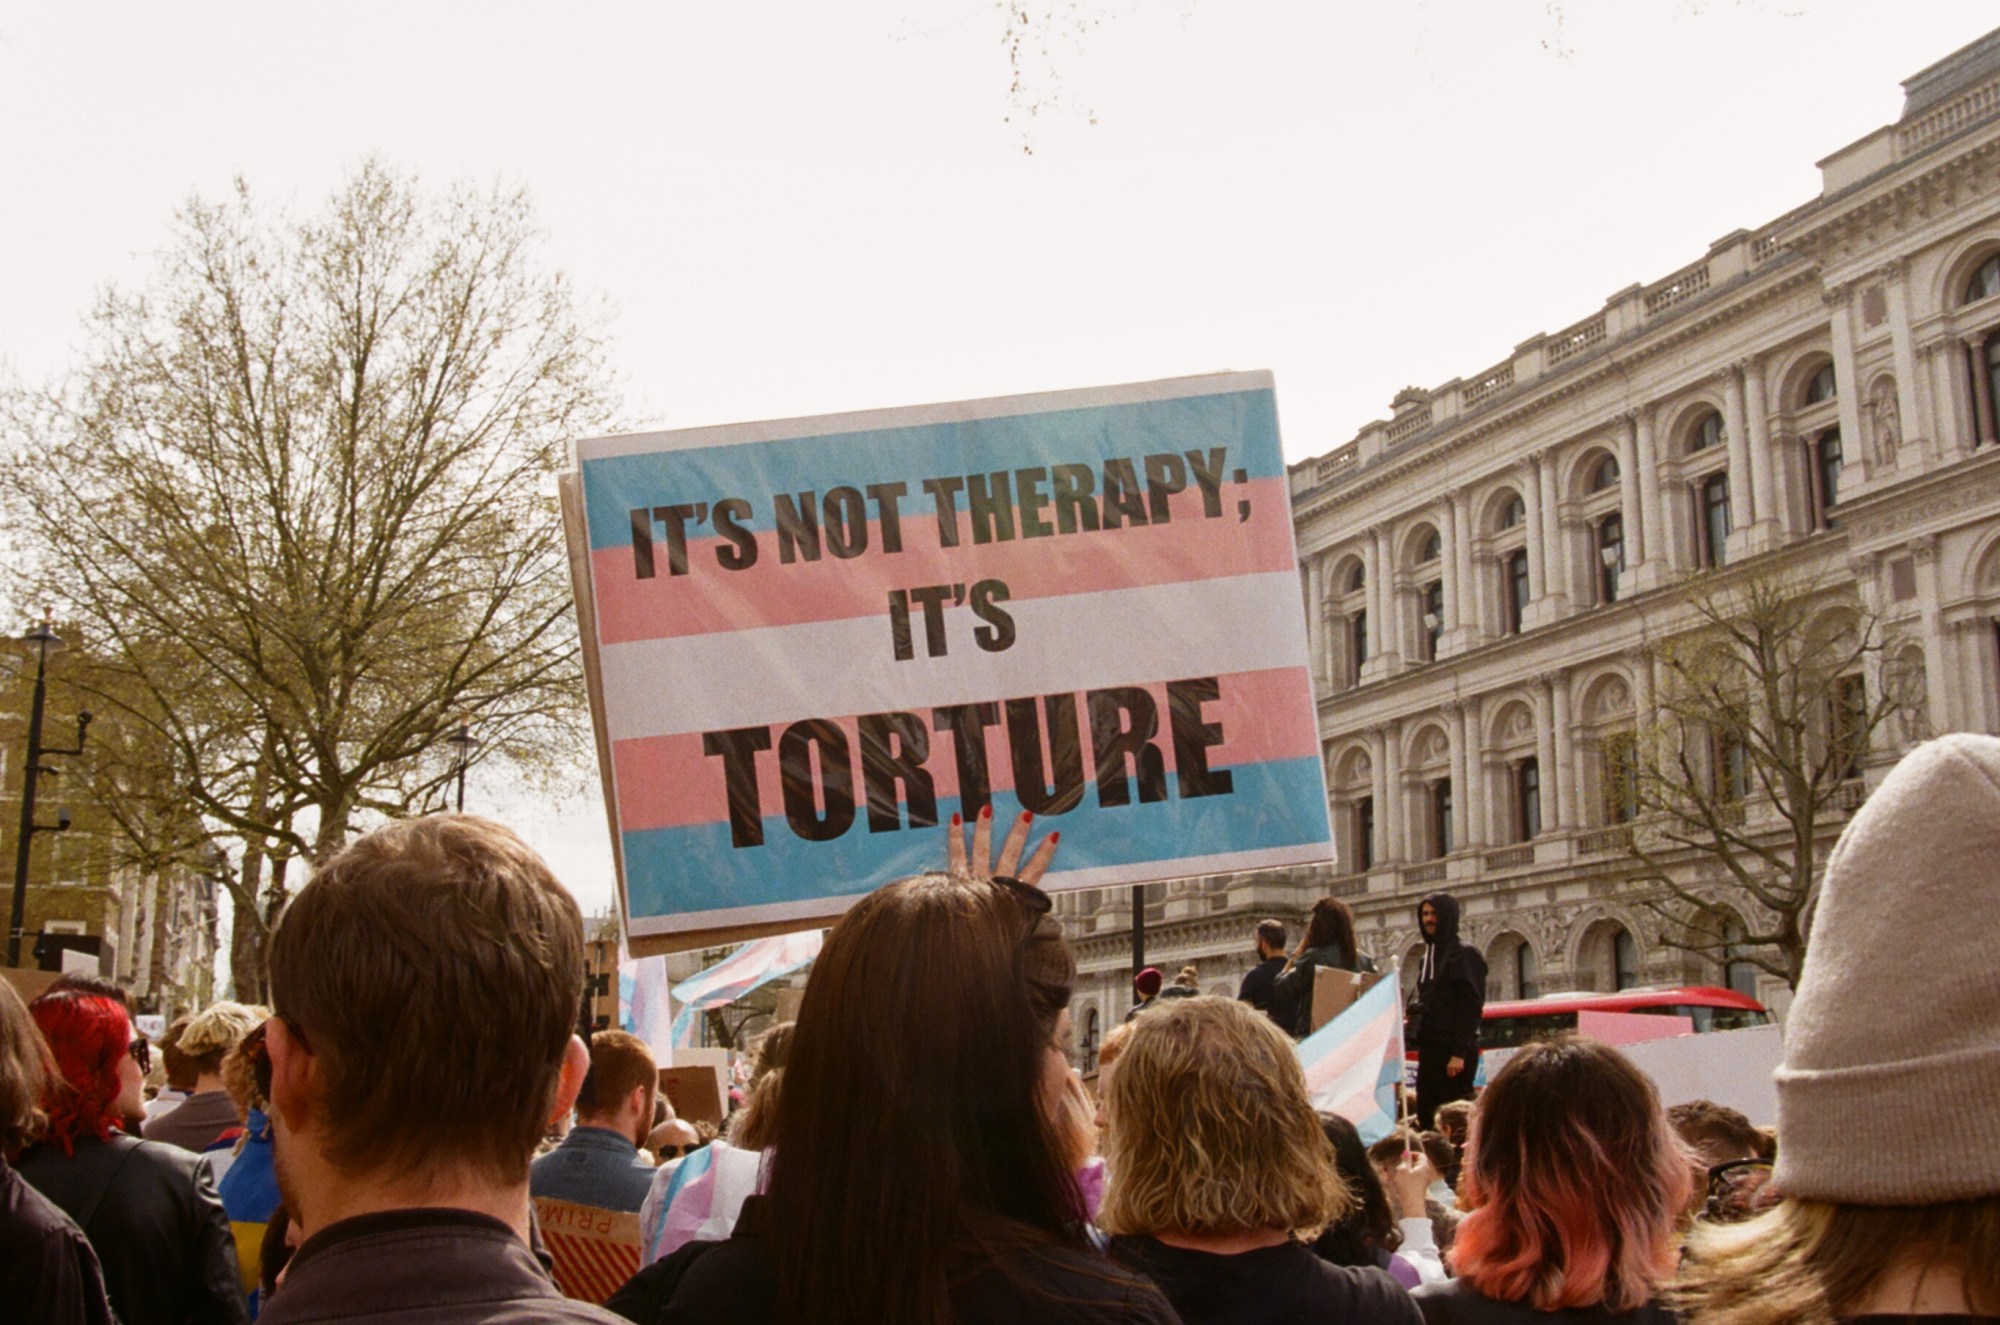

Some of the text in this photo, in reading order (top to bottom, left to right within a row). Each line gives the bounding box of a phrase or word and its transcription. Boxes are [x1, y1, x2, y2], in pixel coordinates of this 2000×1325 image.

[630, 447, 1250, 580] IT'S NOT THERAPY;
[889, 579, 1016, 660] IT'S
[703, 677, 1234, 848] TORTURE
